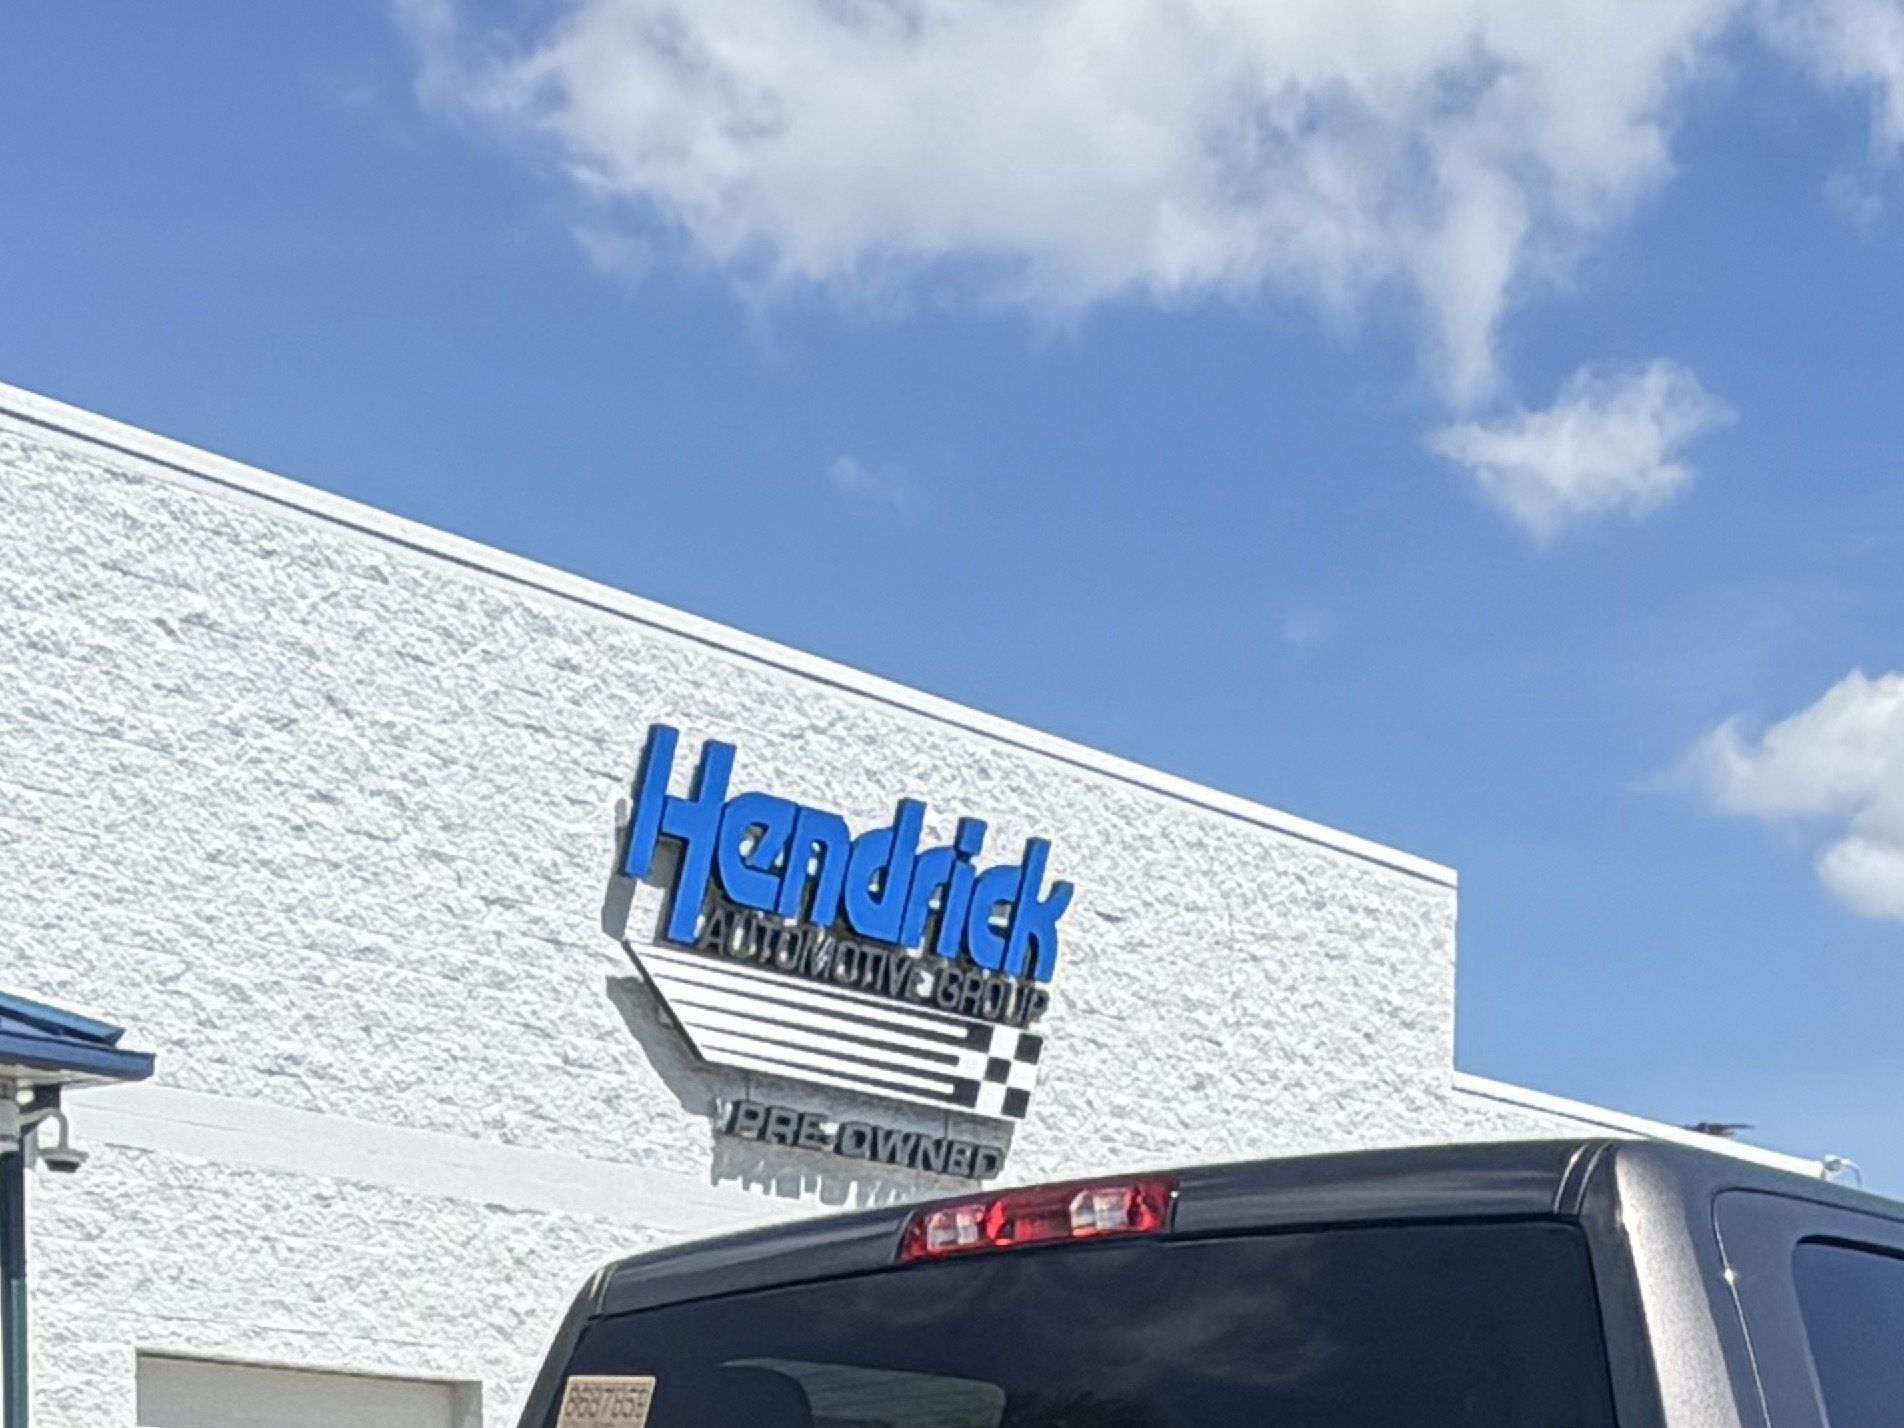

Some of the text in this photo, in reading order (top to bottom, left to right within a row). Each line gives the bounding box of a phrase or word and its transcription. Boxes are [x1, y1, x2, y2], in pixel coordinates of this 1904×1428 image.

[623, 723, 1074, 983] Hendrick
[696, 898, 1050, 1030] AUTOMOTIVE GROUP
